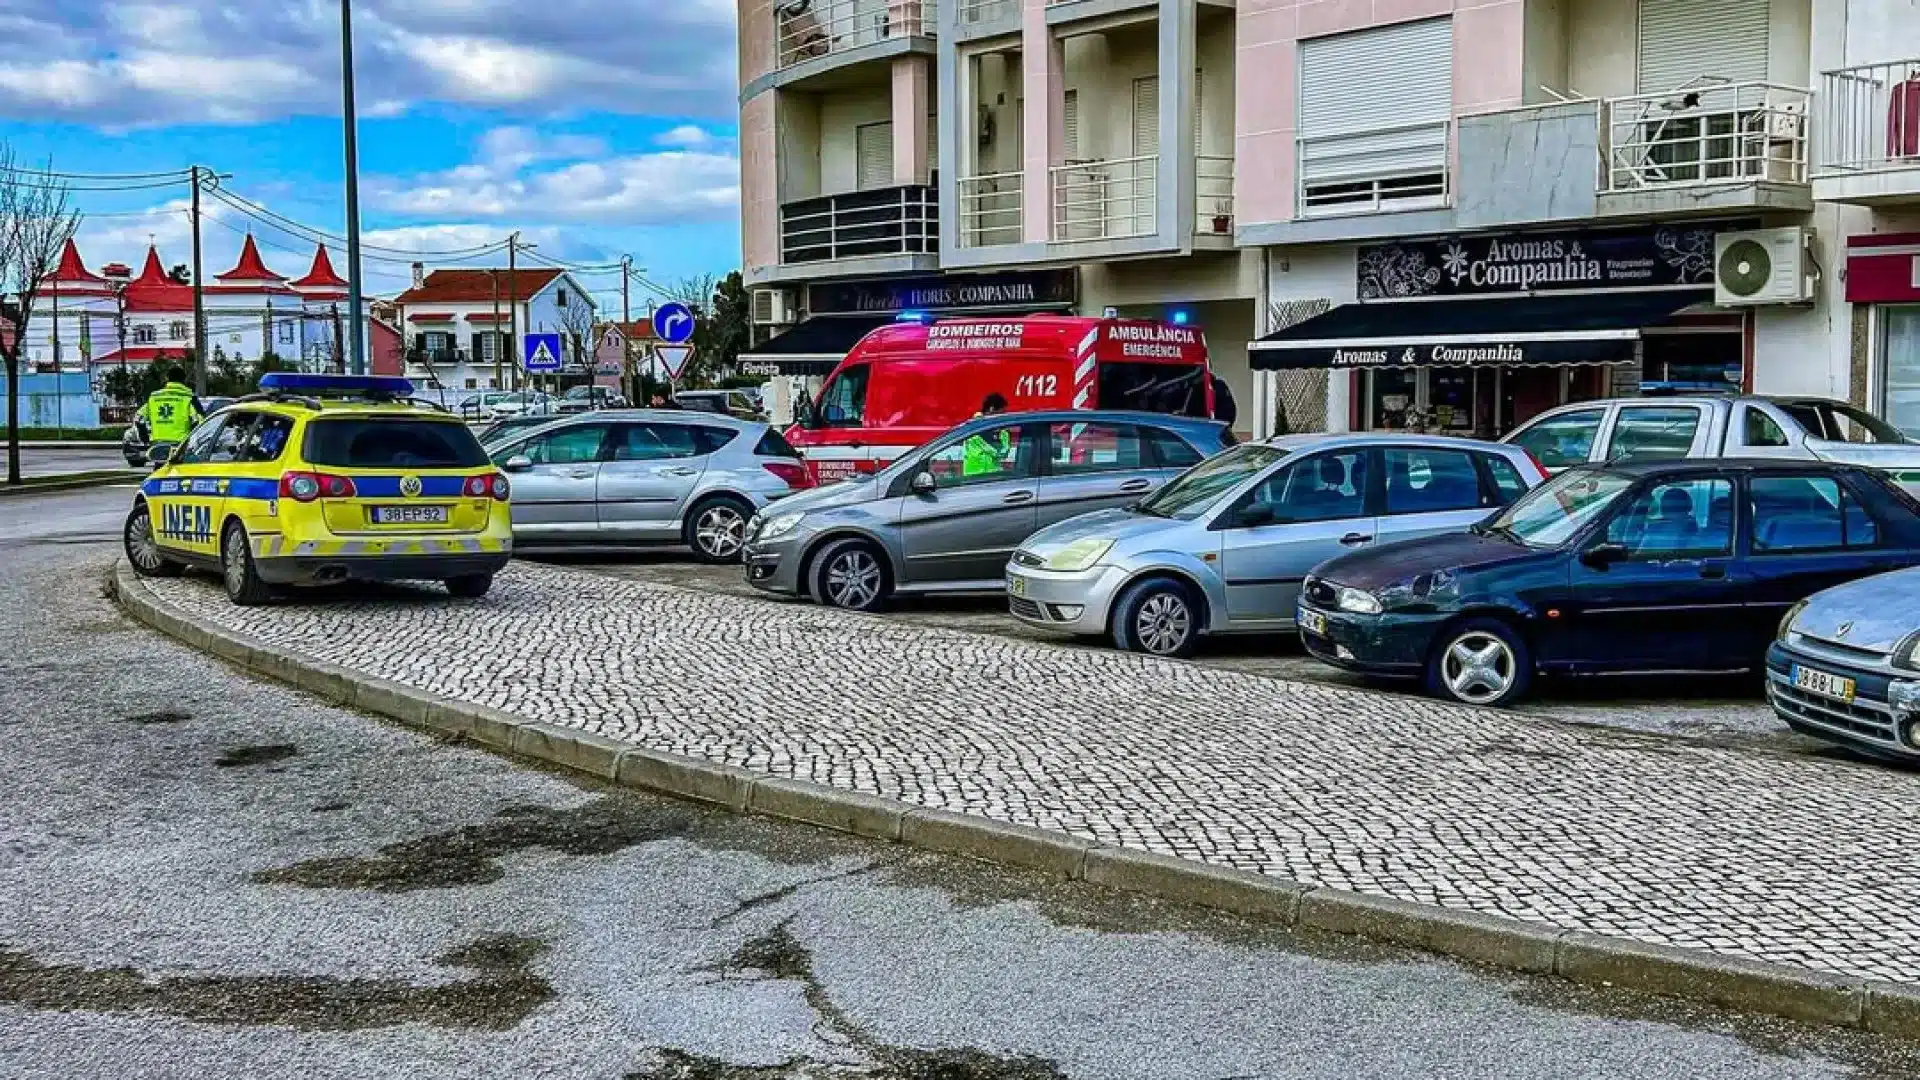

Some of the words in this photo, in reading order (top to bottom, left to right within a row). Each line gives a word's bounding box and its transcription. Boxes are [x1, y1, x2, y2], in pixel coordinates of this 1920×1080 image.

[1487, 239, 1564, 262] Aromas
[1571, 240, 1583, 257] &
[1469, 252, 1601, 289] Companhia
[959, 283, 1035, 304] COMPANHIA
[928, 323, 1024, 338] BOMBEIROS
[1108, 324, 1196, 344] AMBULÂNCIA
[1331, 347, 1388, 364] Aromas
[1402, 347, 1416, 363] &
[1431, 343, 1524, 365] Companhia
[1024, 374, 1057, 397] 112
[162, 502, 212, 544] INEM
